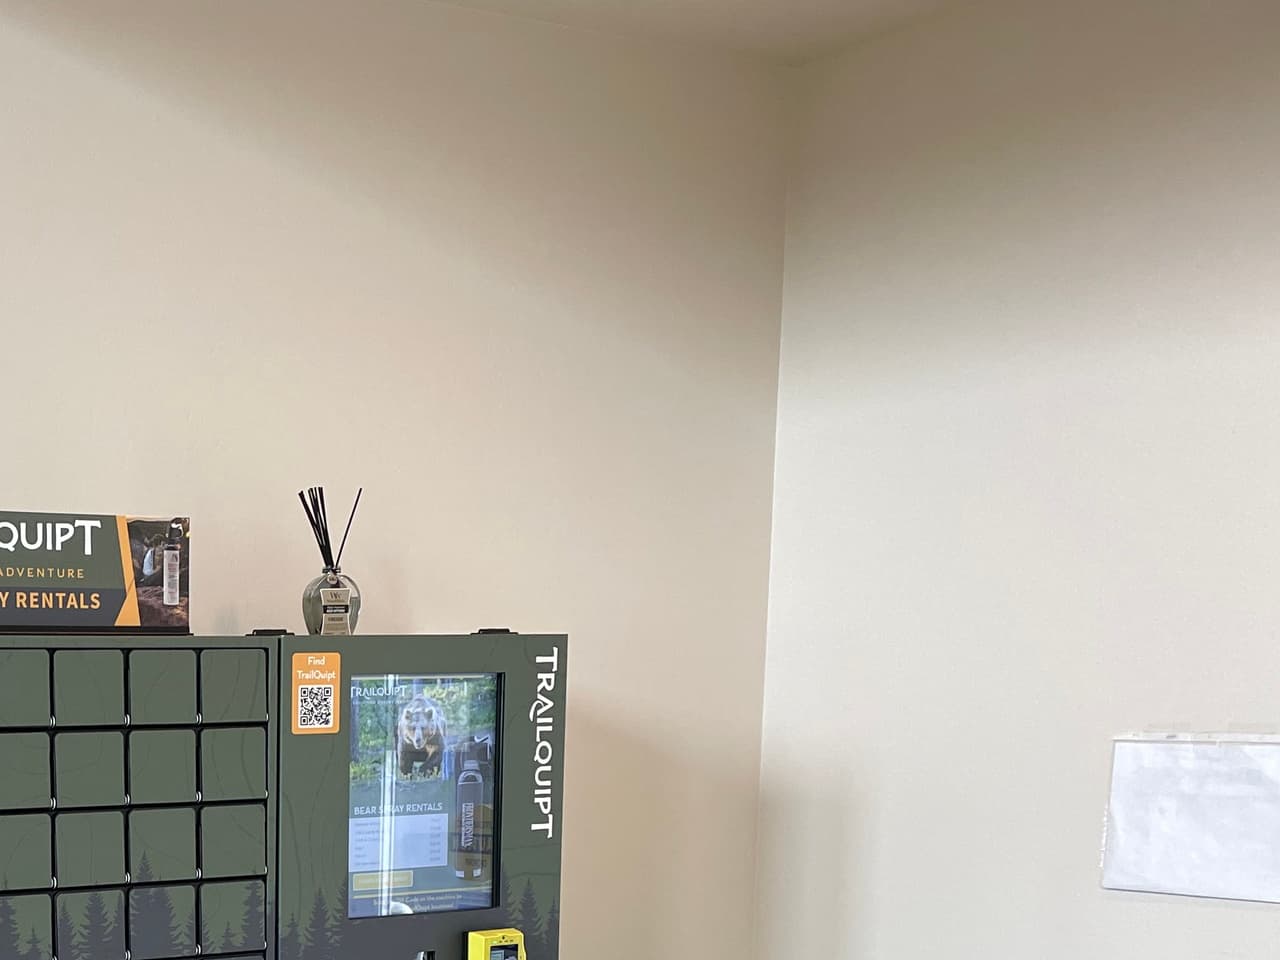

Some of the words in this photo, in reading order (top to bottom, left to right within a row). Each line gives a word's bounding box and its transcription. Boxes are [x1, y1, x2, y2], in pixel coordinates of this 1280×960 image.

[16, 592, 101, 609] RENTALS
[307, 655, 326, 665] Find
[296, 670, 337, 682] TrailQuipt
[529, 646, 558, 839] TRAILQUIPT
[354, 806, 376, 815] BEAR
[378, 804, 405, 814] SAY
[406, 802, 443, 812] RENTALS
